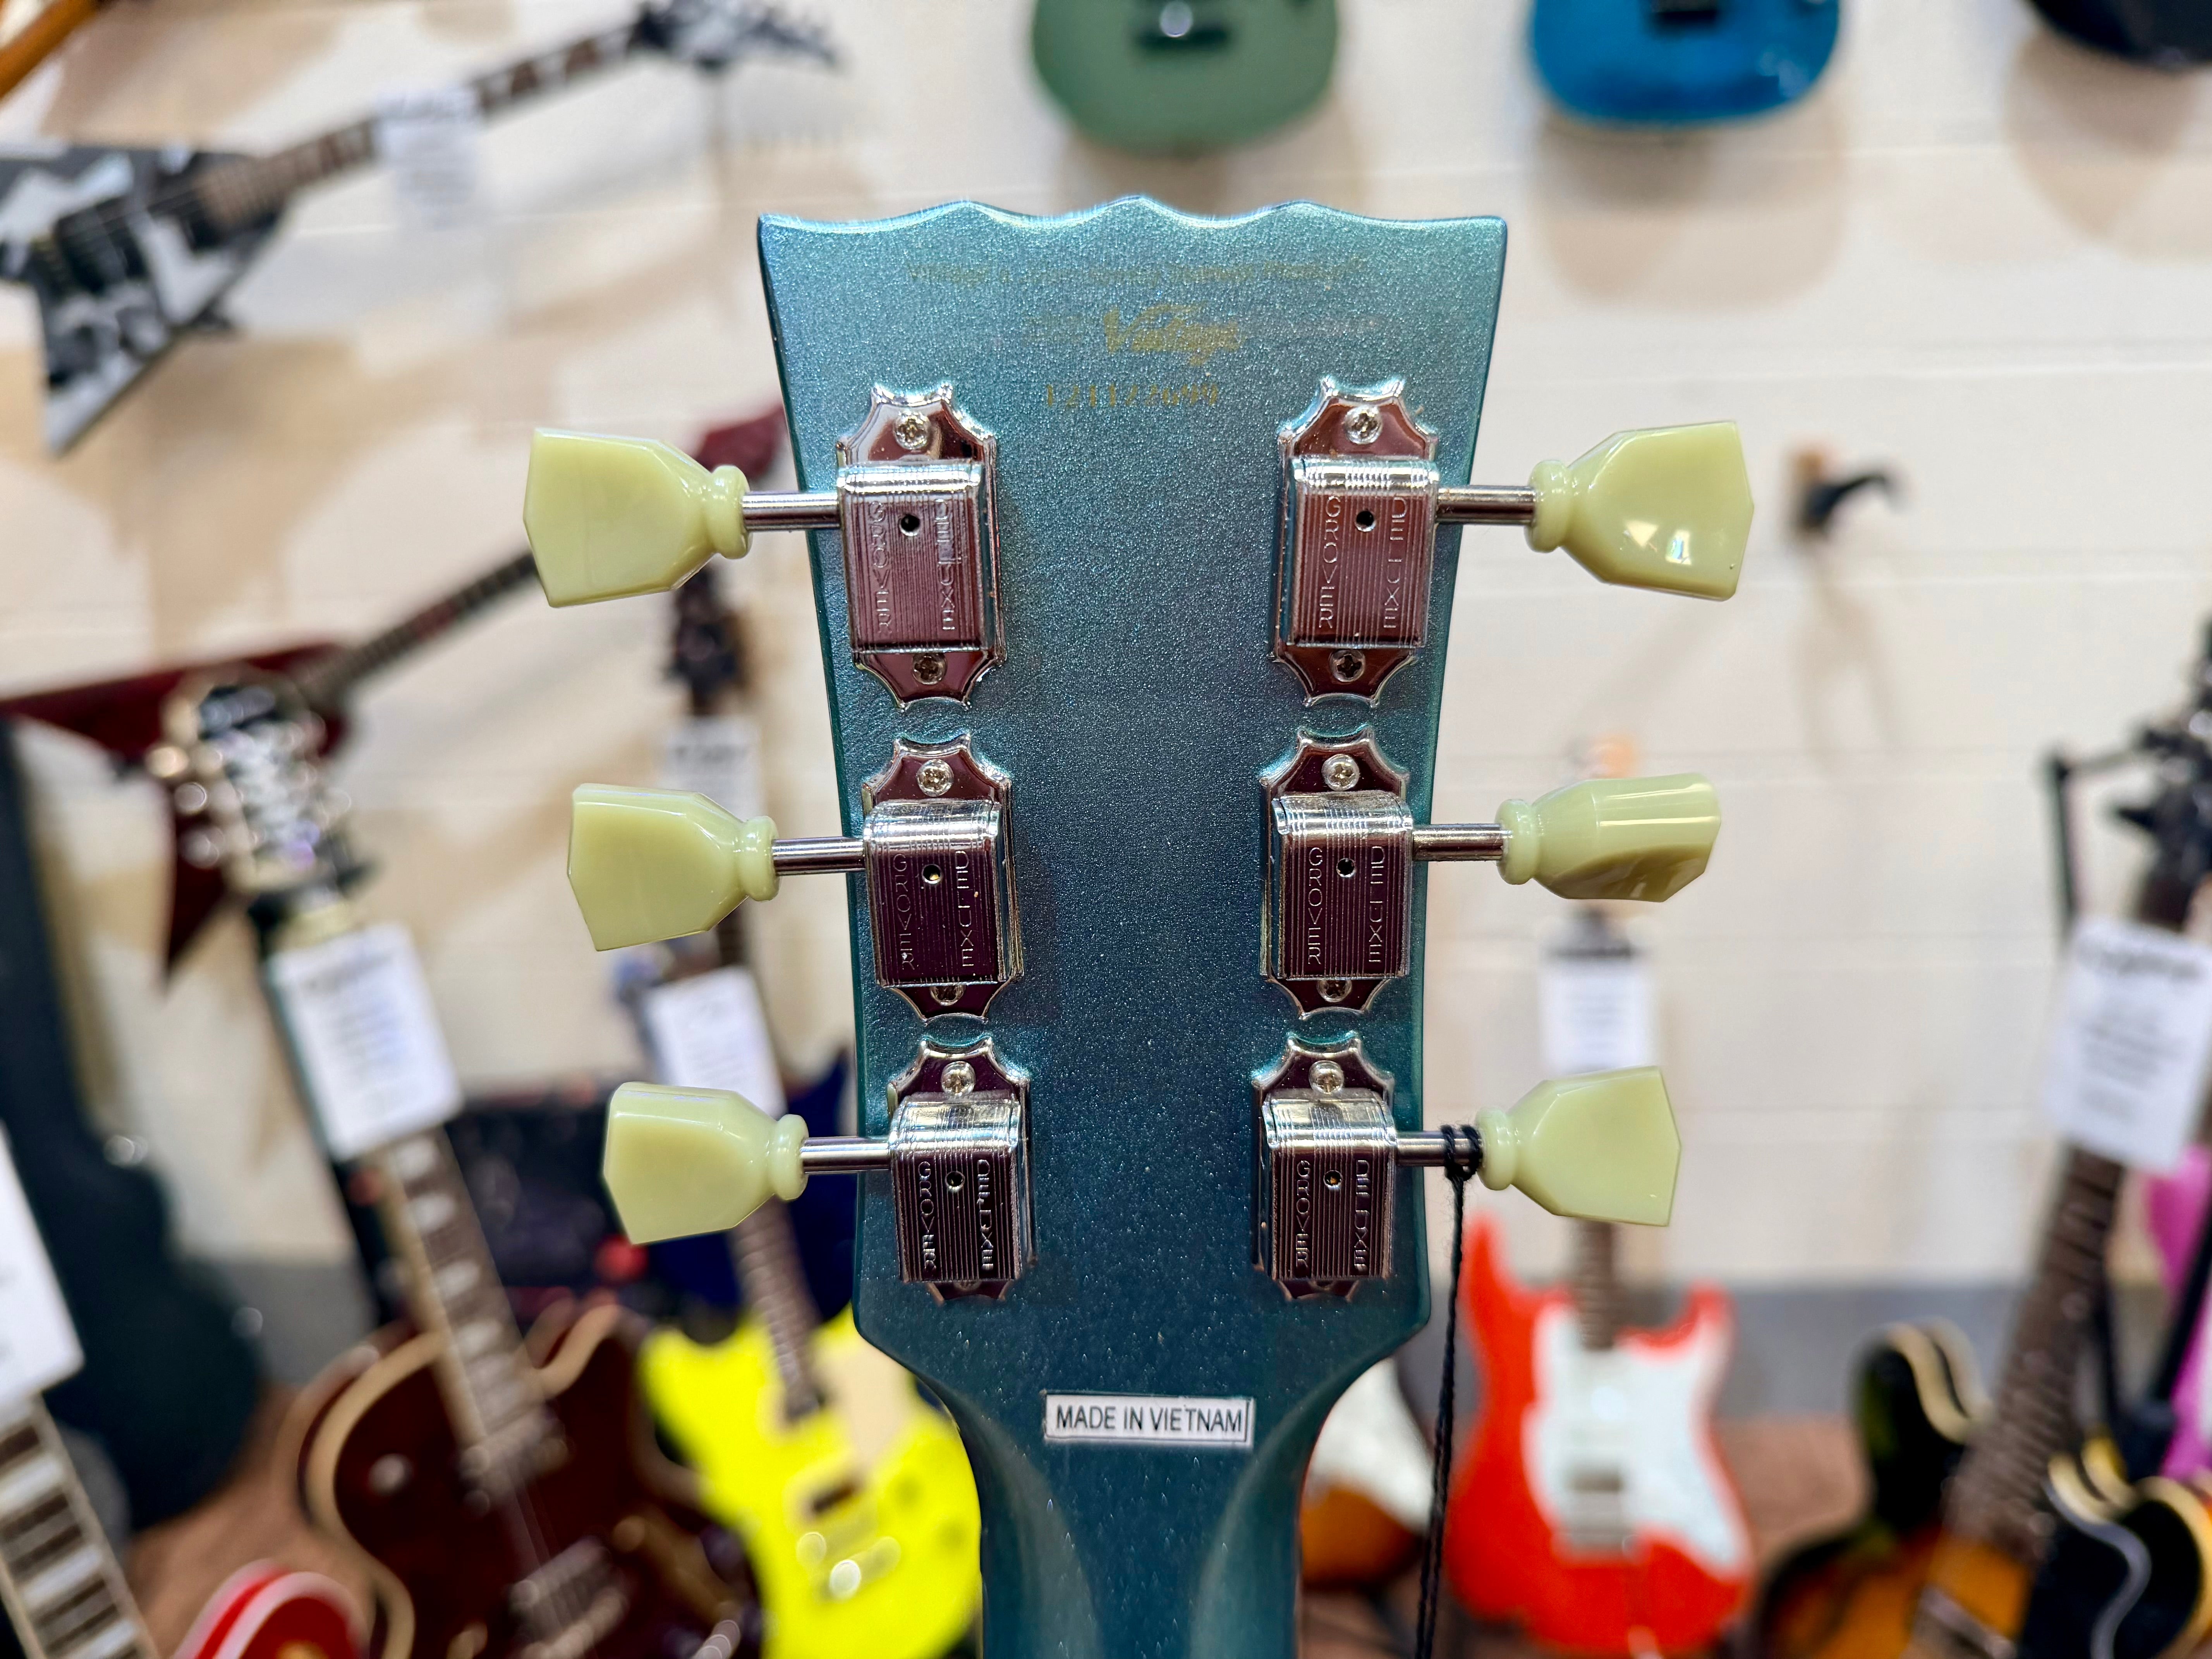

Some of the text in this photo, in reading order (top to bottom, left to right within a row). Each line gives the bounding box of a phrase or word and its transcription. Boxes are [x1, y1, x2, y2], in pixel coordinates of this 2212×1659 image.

[869, 501, 892, 634] GROVER
[934, 498, 956, 630] DELUXE
[1319, 495, 1341, 629] GROVER
[1383, 497, 1408, 628] DELUXE
[893, 854, 915, 970] GROVER
[955, 850, 974, 967] DELUXE
[1307, 847, 1323, 965] GROVER
[1369, 846, 1386, 963] DELUXE
[918, 1161, 936, 1271] GROVER
[977, 1159, 993, 1270] DELUXE
[1296, 1160, 1310, 1268] GROVER
[1354, 1160, 1370, 1269] DELUXE
[1056, 1404, 1241, 1432] MADE IN VIETNAM
